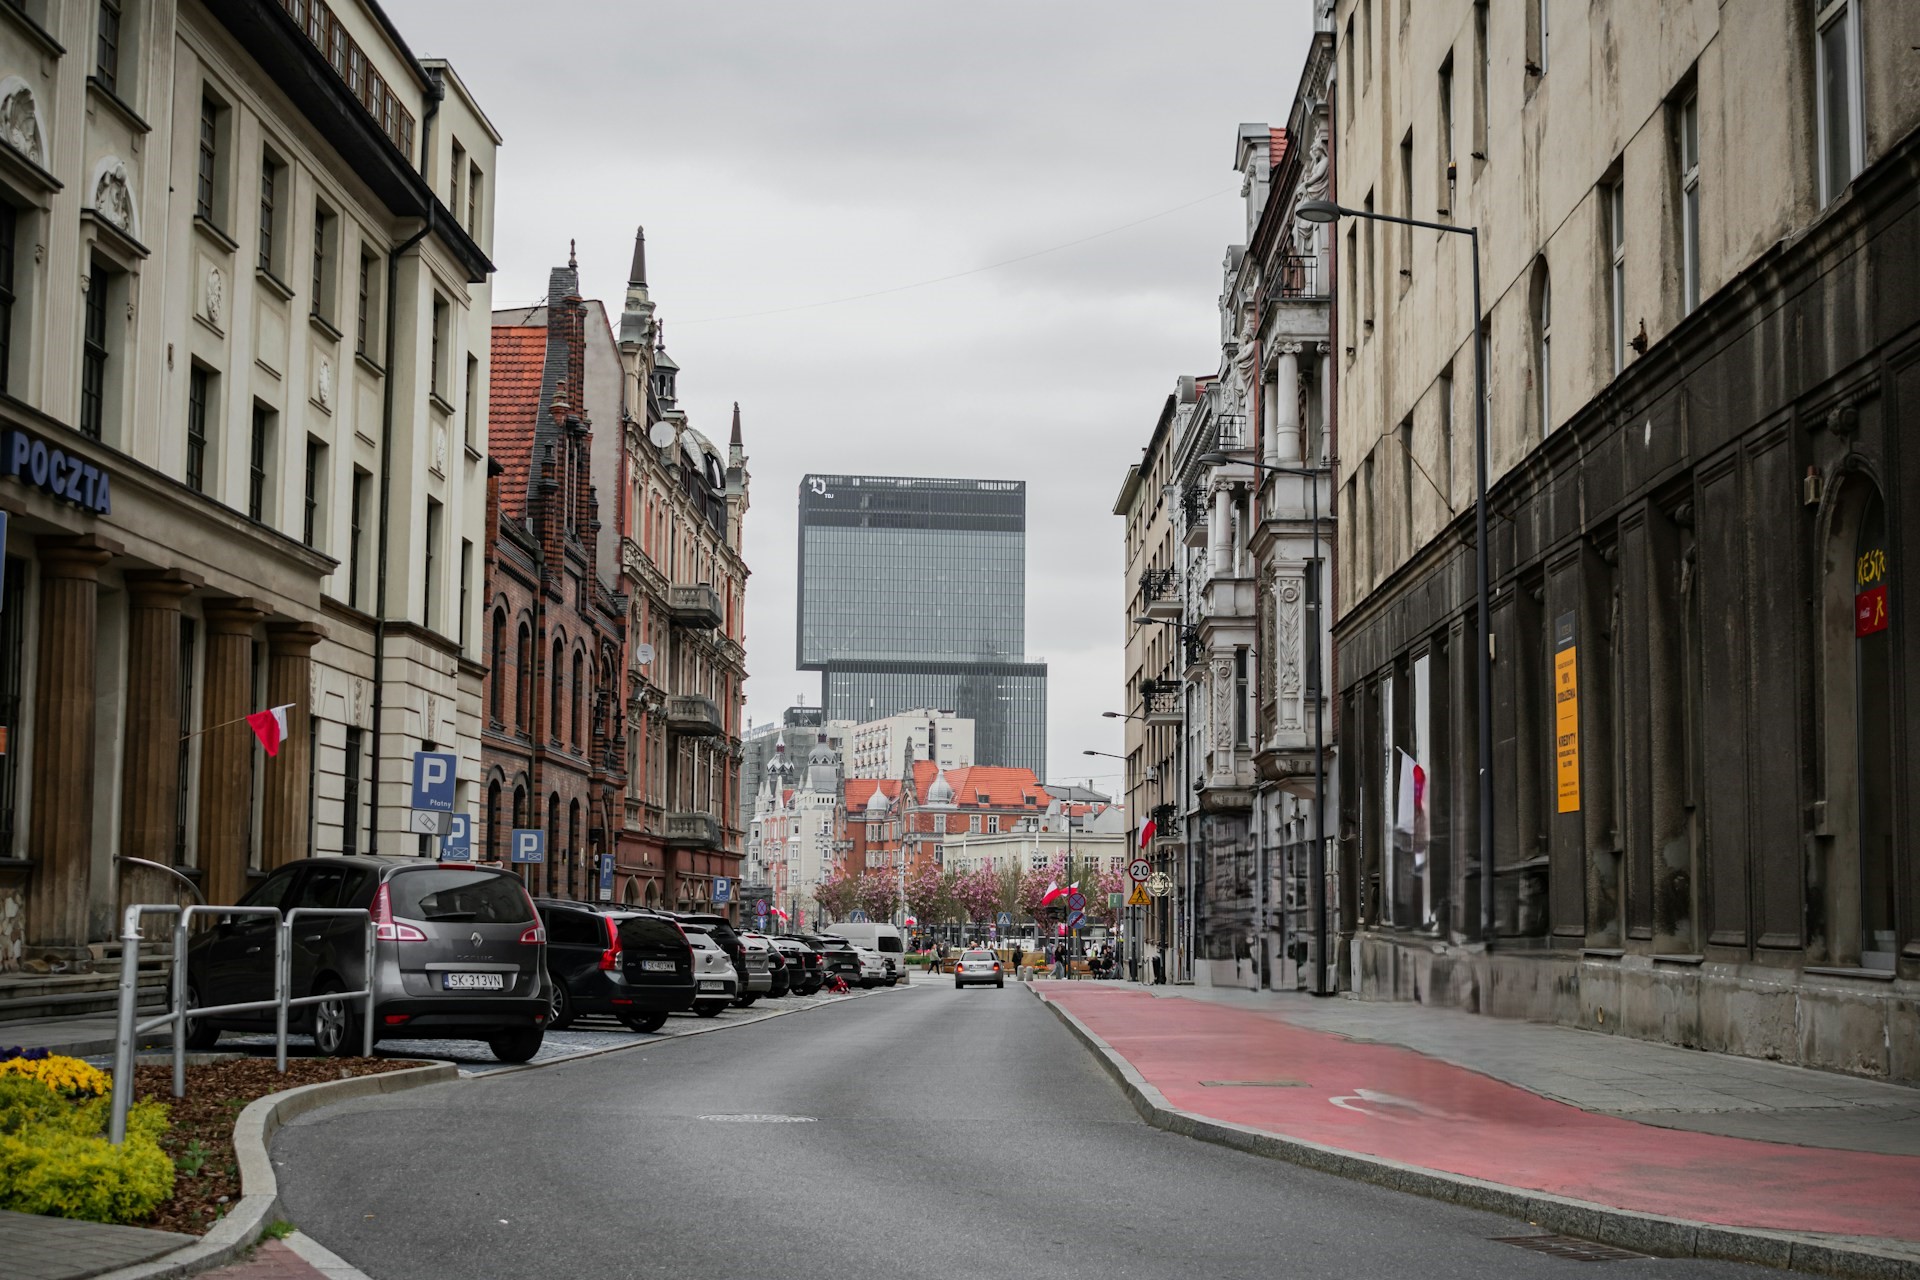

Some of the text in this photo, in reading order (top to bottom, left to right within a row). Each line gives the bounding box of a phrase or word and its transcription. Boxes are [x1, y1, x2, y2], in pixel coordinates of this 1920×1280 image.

[12, 431, 111, 515] POCZTA
[422, 757, 447, 792] P
[430, 798, 452, 808] Płatny
[448, 818, 465, 846] P
[520, 834, 538, 858] P
[1133, 865, 1148, 876] 20
[716, 880, 727, 895] P
[451, 974, 501, 986] SK 313VN
